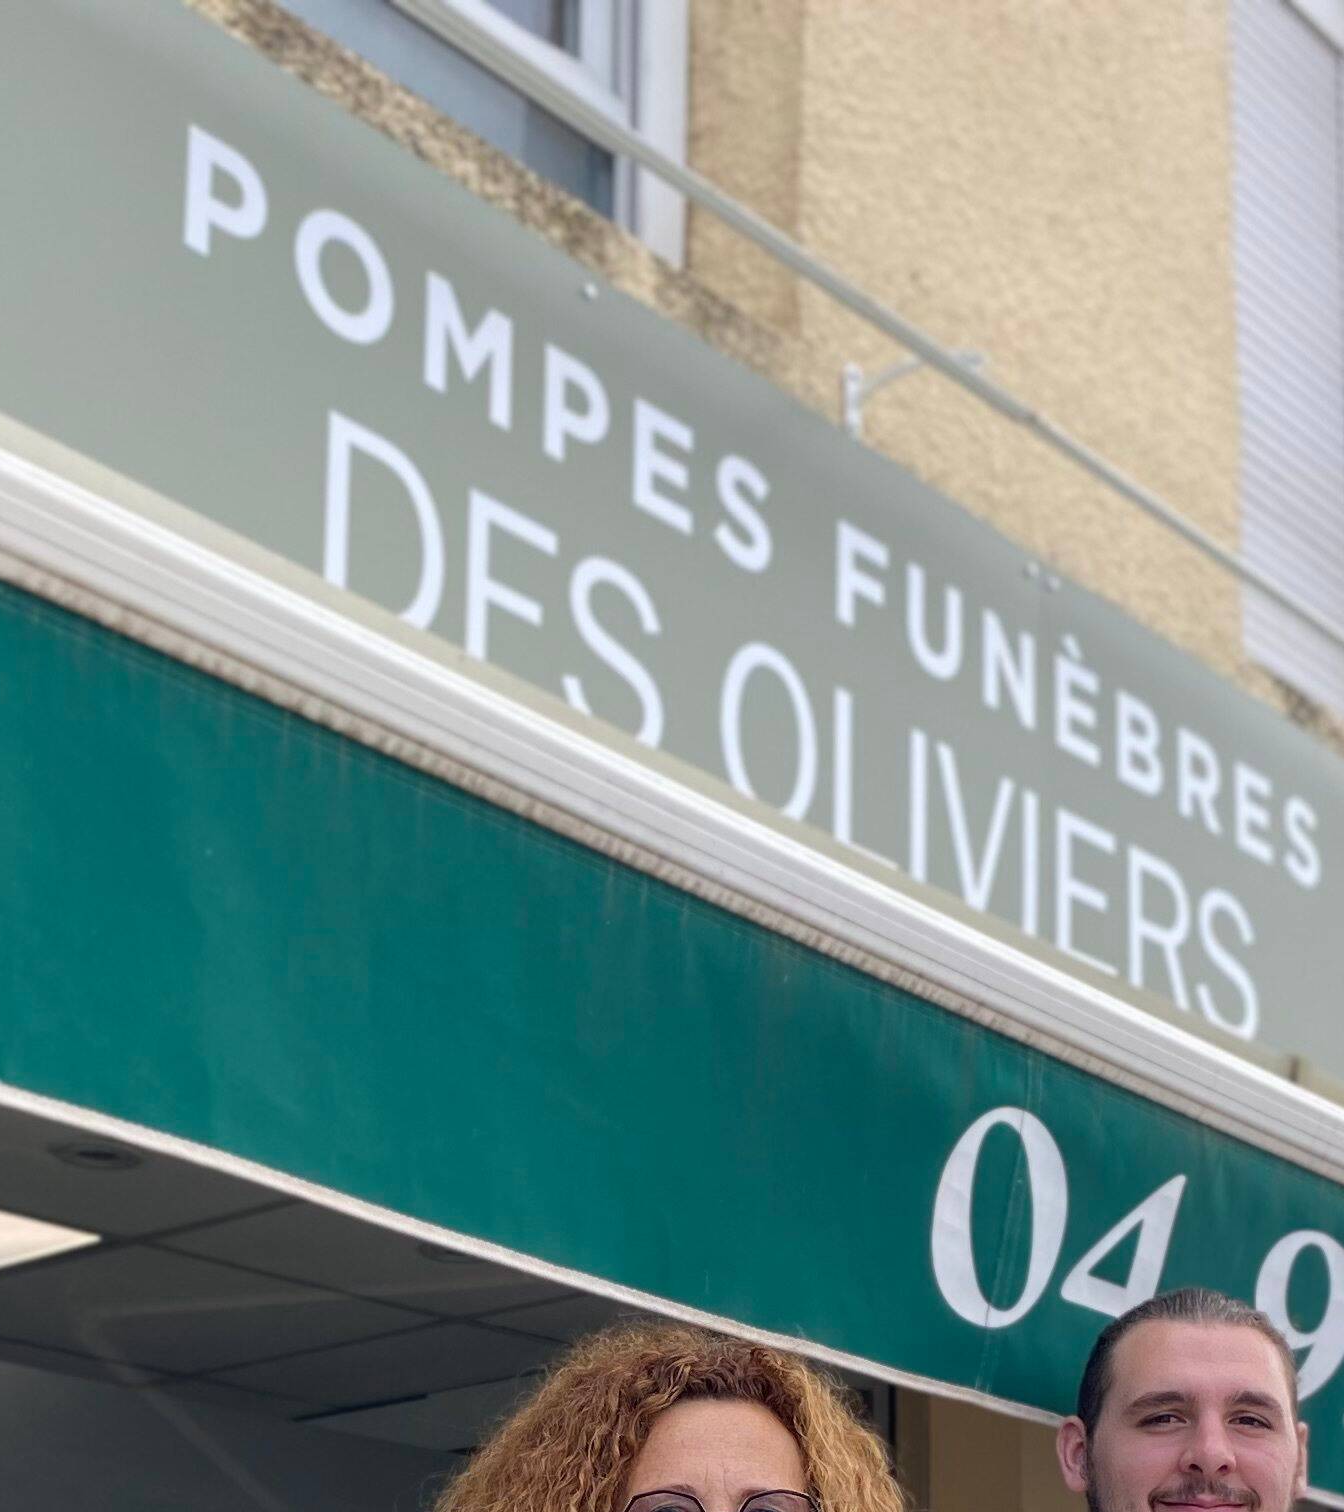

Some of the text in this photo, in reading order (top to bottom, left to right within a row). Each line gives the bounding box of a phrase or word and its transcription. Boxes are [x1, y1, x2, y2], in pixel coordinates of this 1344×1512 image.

[183, 123, 1323, 890] POMPES FUNÈBRES
[323, 408, 1260, 1042] DES OLIVIERS
[931, 1105, 1188, 1330] 04
